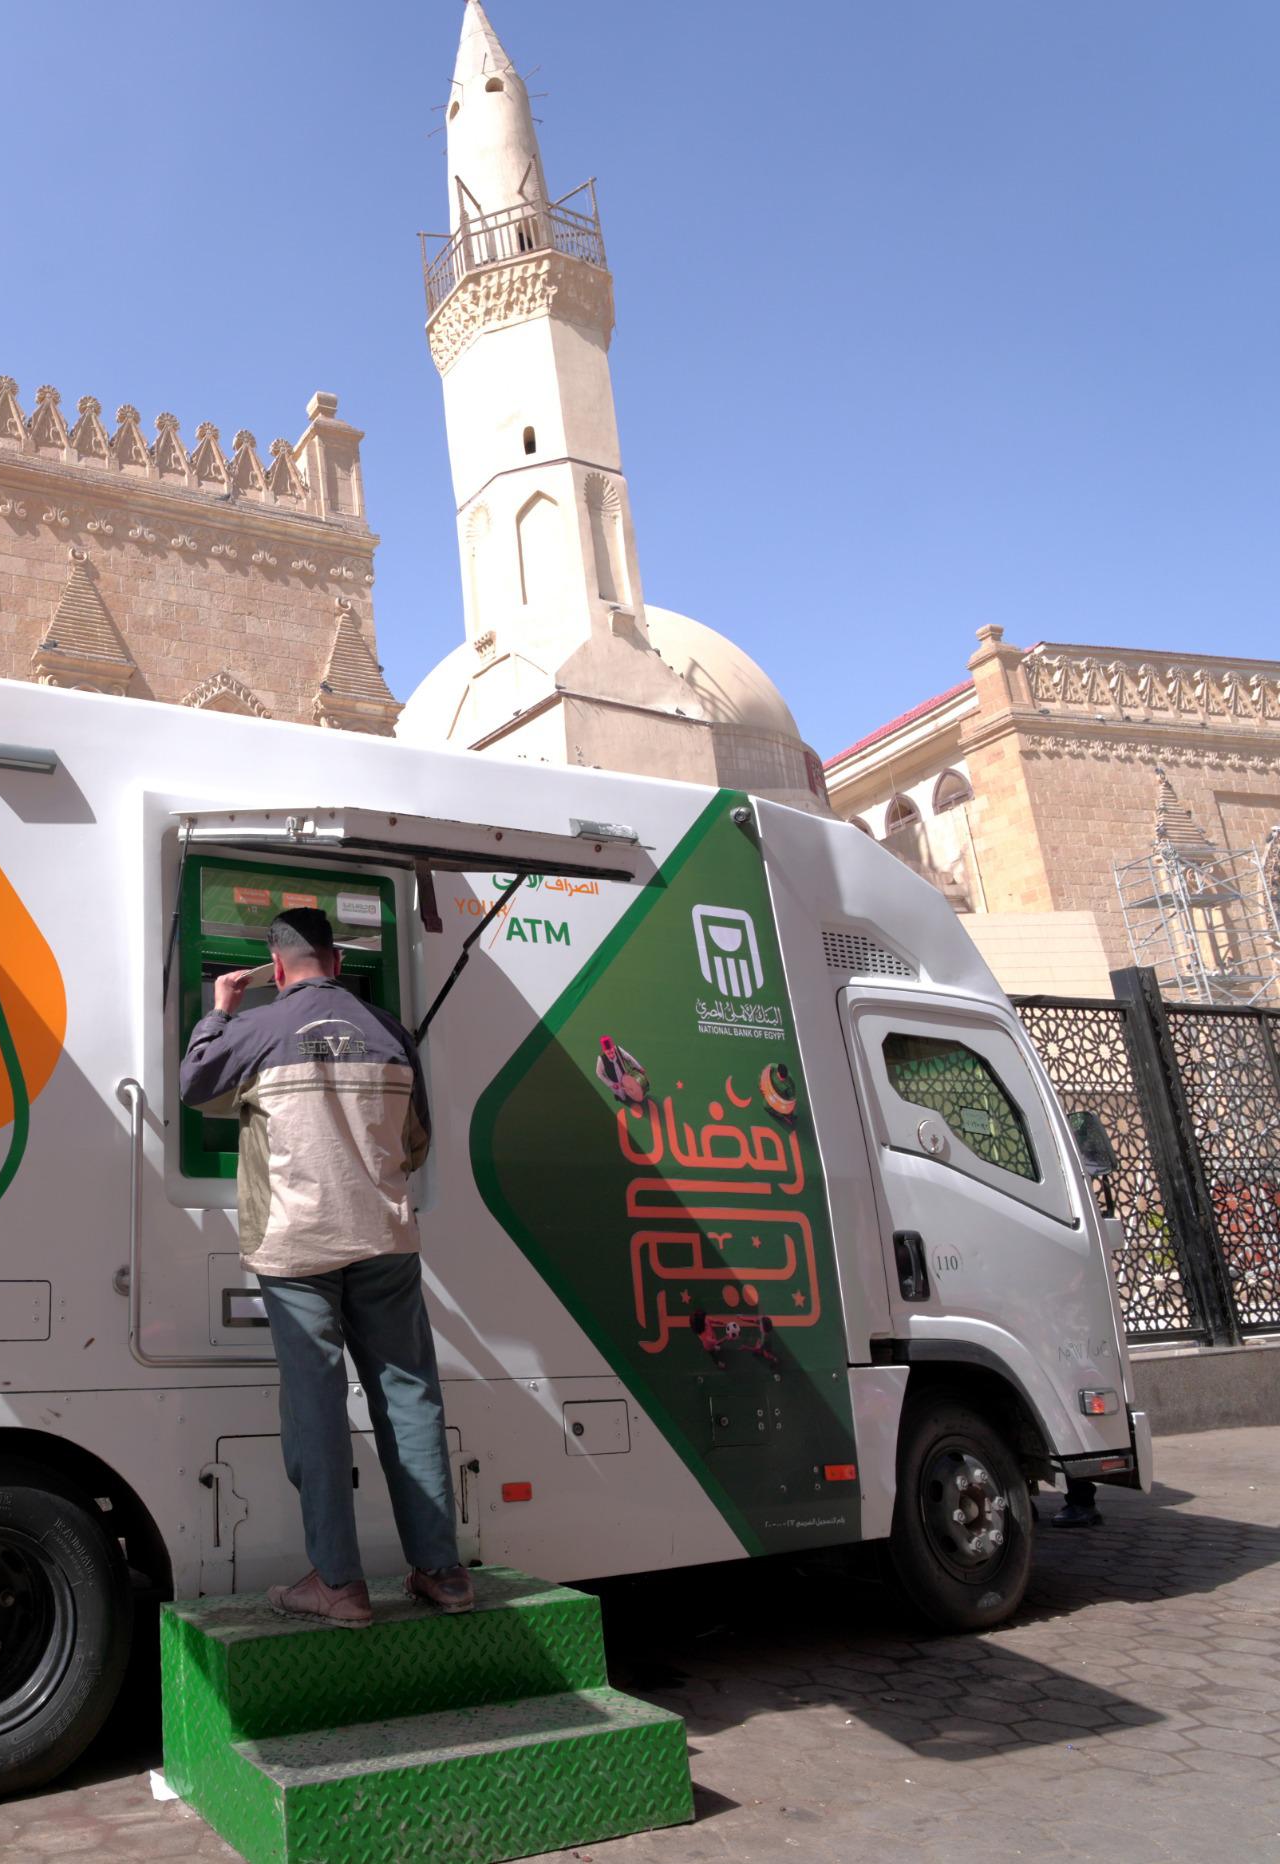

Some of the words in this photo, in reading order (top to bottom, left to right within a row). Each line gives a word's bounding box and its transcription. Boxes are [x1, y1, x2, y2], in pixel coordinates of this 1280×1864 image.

[505, 916, 571, 946] ATM
[698, 1024, 733, 1037] NATIONAL
[733, 1027, 754, 1038] BANK
[753, 1030, 764, 1039] OF
[764, 1031, 786, 1041] EGYPT
[616, 1095, 805, 1195] رمضان
[935, 1254, 959, 1273] 110
